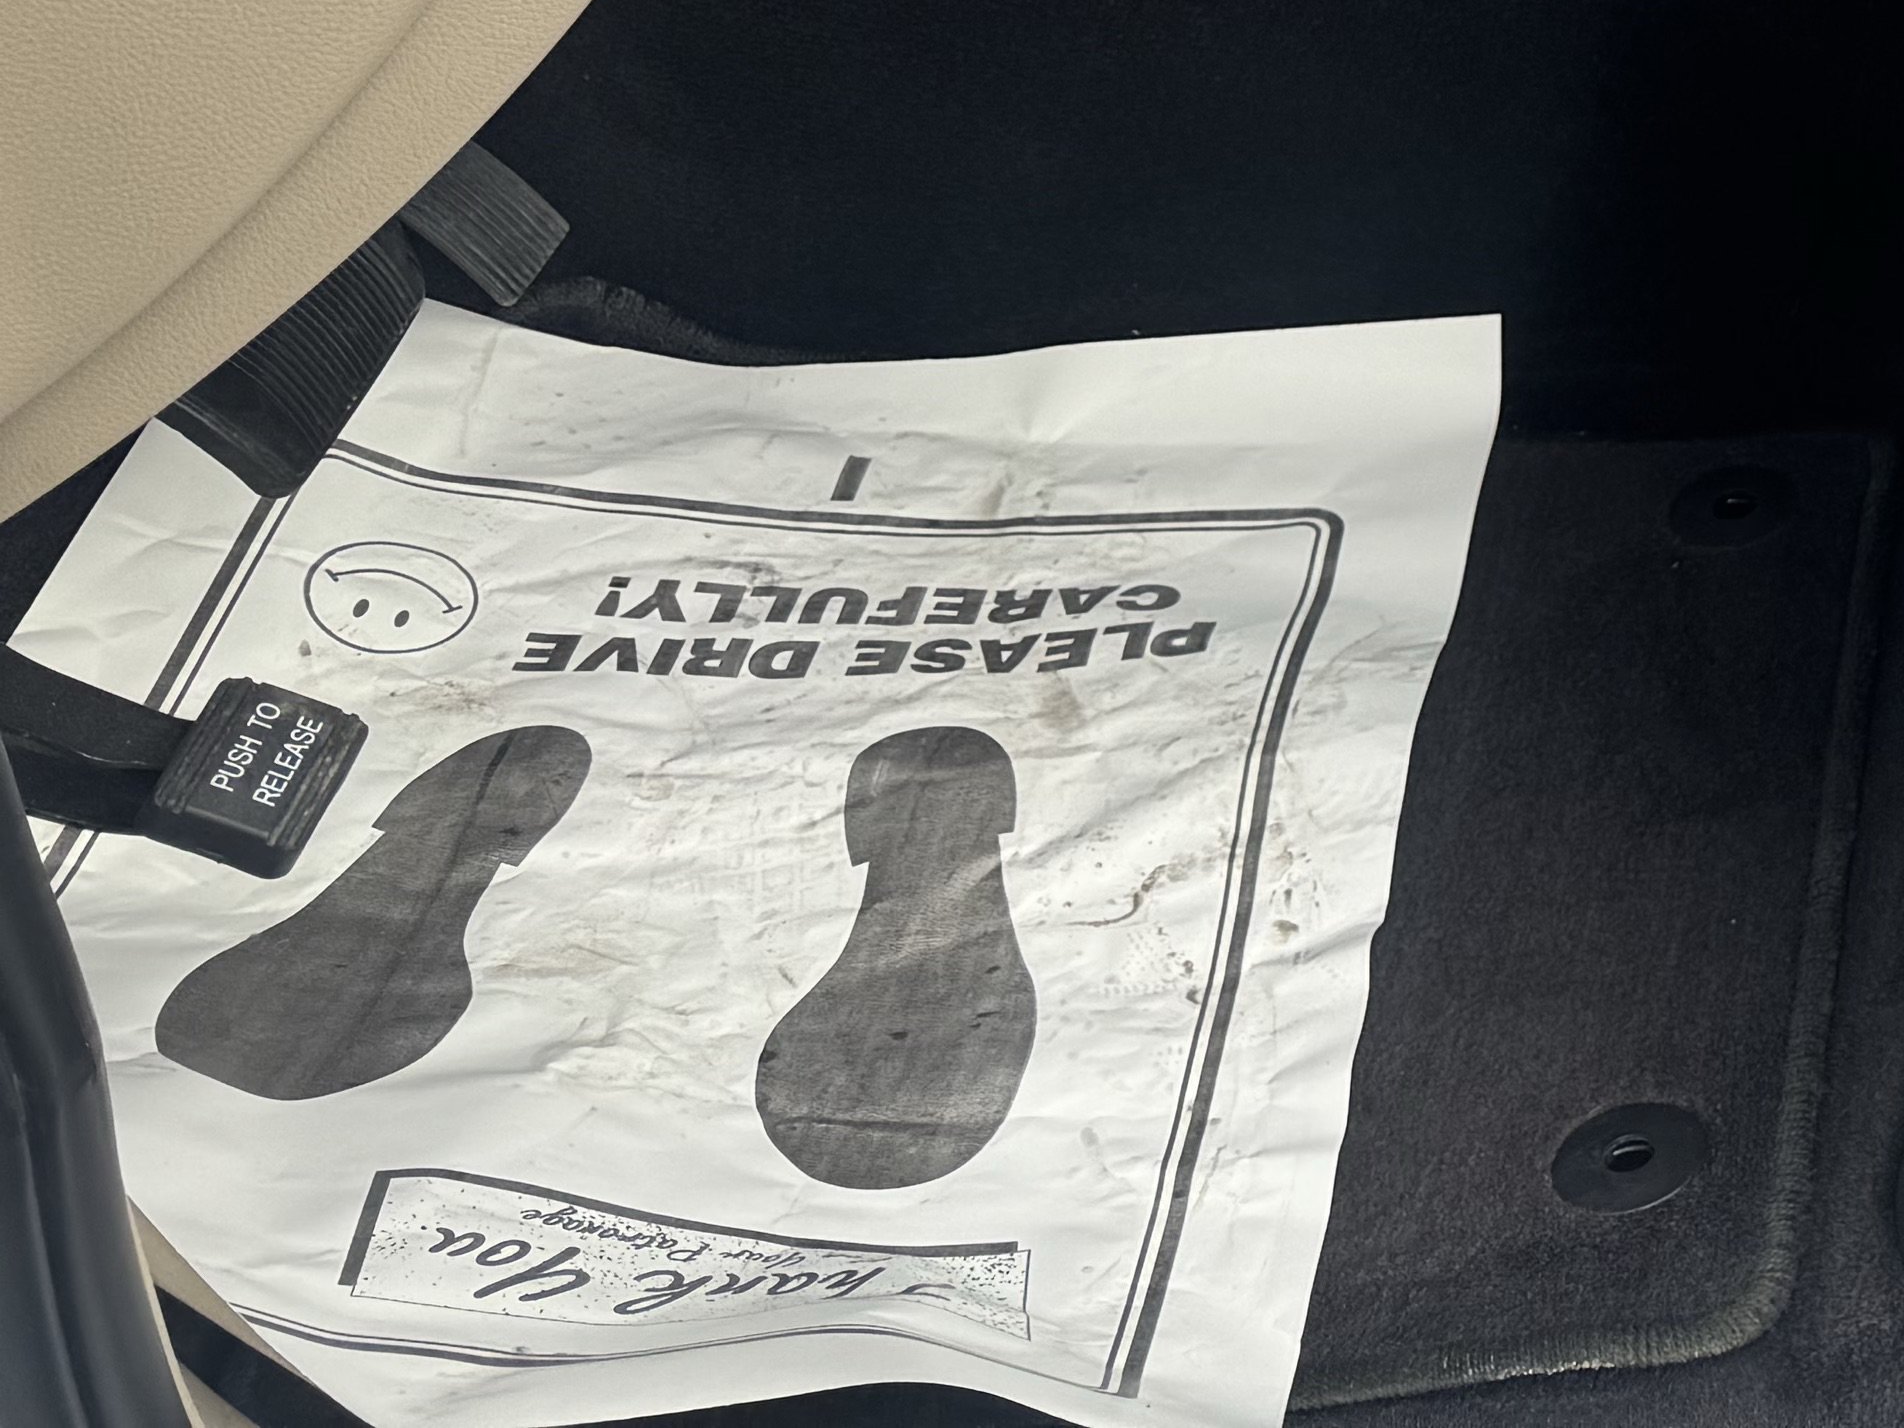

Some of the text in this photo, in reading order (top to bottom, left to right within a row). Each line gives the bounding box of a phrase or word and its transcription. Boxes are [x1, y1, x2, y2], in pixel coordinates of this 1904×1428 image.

[594, 575, 1181, 626] CAREFULLY!
[511, 621, 1217, 680] PLEASE DRIVE
[209, 702, 281, 793] PUSH TO
[251, 715, 324, 807] RELEASE
[519, 1205, 711, 1263] Patronage
